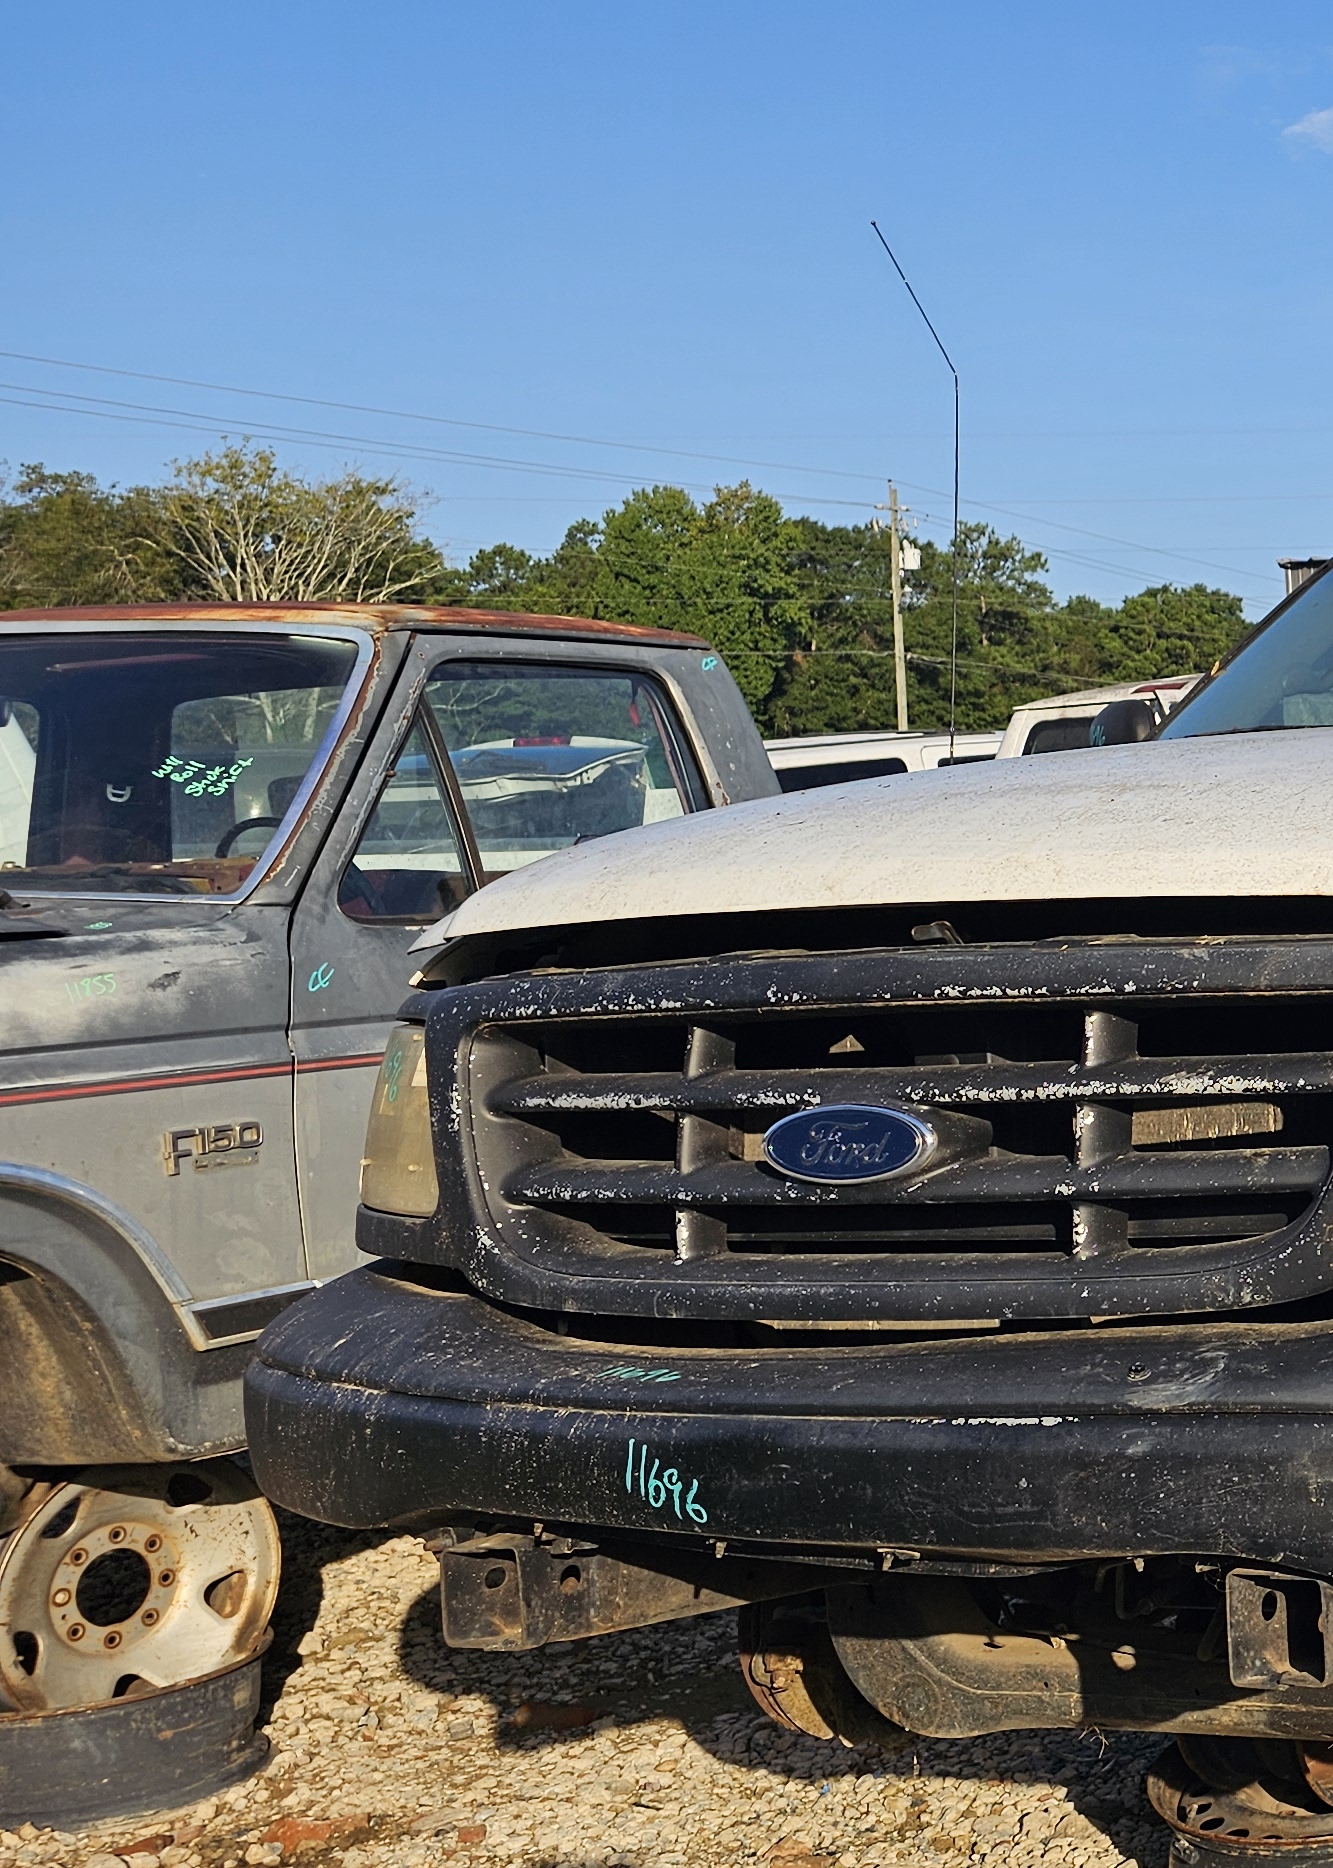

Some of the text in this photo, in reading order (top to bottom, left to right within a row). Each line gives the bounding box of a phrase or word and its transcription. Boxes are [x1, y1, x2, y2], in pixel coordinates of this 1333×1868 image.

[163, 1121, 264, 1176] F150
[801, 1120, 893, 1168] Ford
[625, 1438, 708, 1524] 11696
